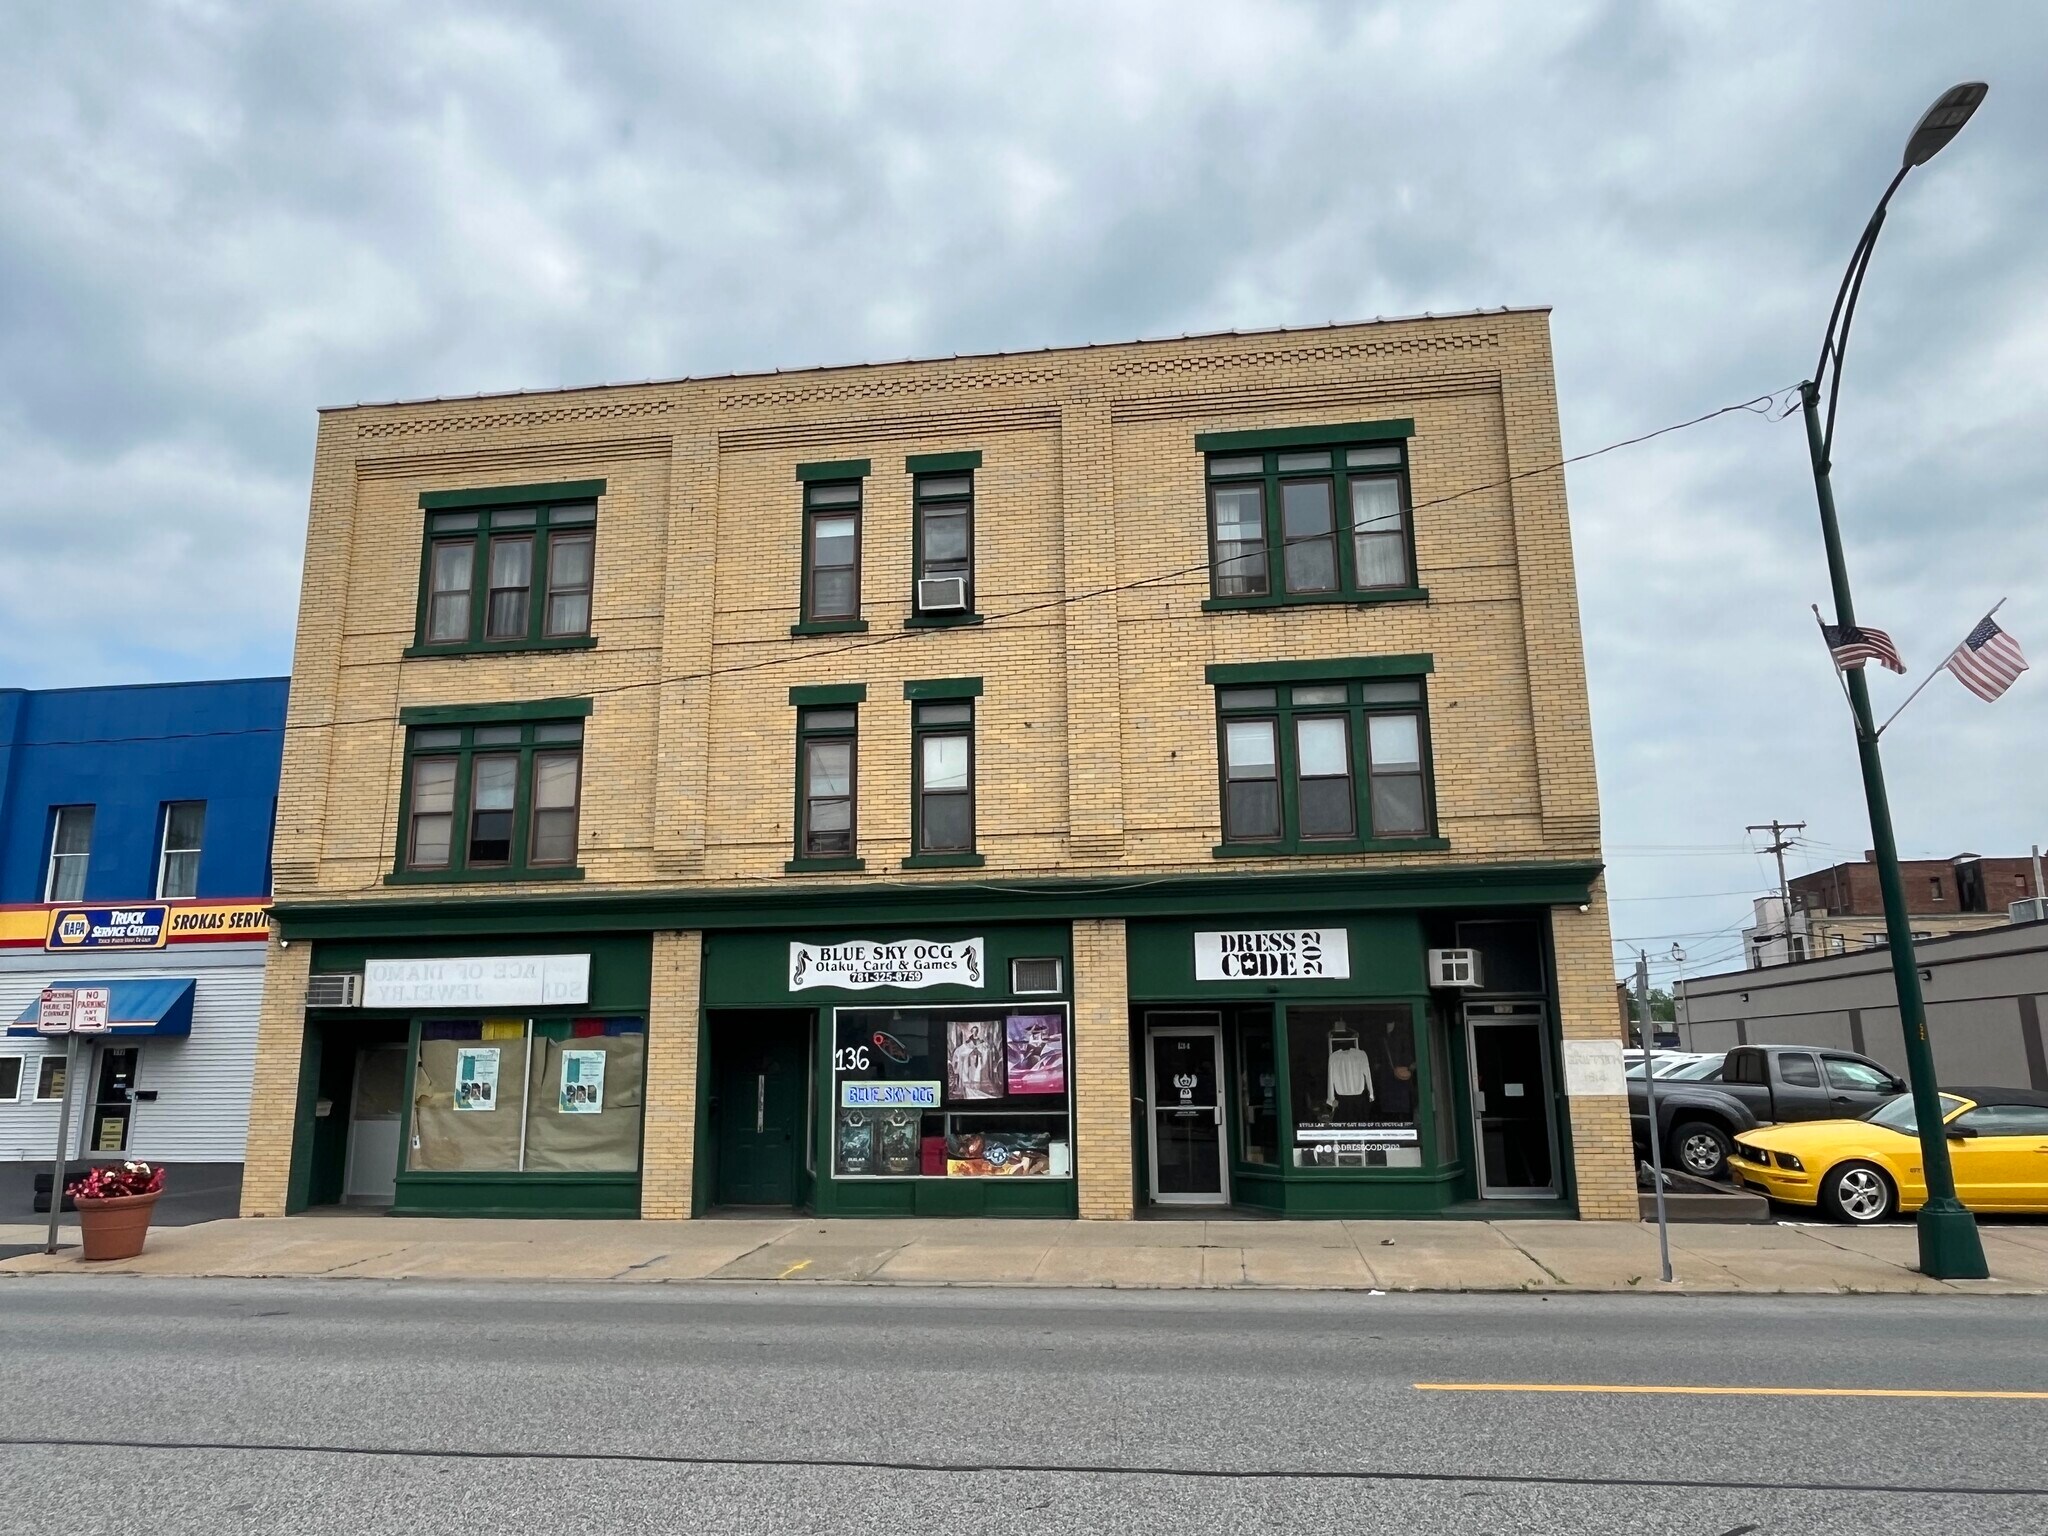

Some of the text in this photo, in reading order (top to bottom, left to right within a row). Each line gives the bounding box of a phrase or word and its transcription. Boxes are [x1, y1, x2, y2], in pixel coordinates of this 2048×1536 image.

[110, 911, 146, 926] TRUCK
[172, 913, 225, 930] SROKAS
[63, 921, 86, 936] NAPA
[91, 925, 160, 938] SERVICE CENTER
[1220, 932, 1296, 953] DRESS
[820, 945, 953, 961] BLUE SKY OCG
[1301, 931, 1322, 975] 202
[815, 960, 958, 973] Otaku, Card & Games
[1221, 952, 1298, 977] CODE
[851, 971, 922, 983] 781-325-8759
[86, 991, 99, 999] NO
[77, 1000, 106, 1008] PARKING
[835, 1045, 870, 1071] 136
[848, 1087, 879, 1103] BLUE
[884, 1086, 906, 1102] SKY
